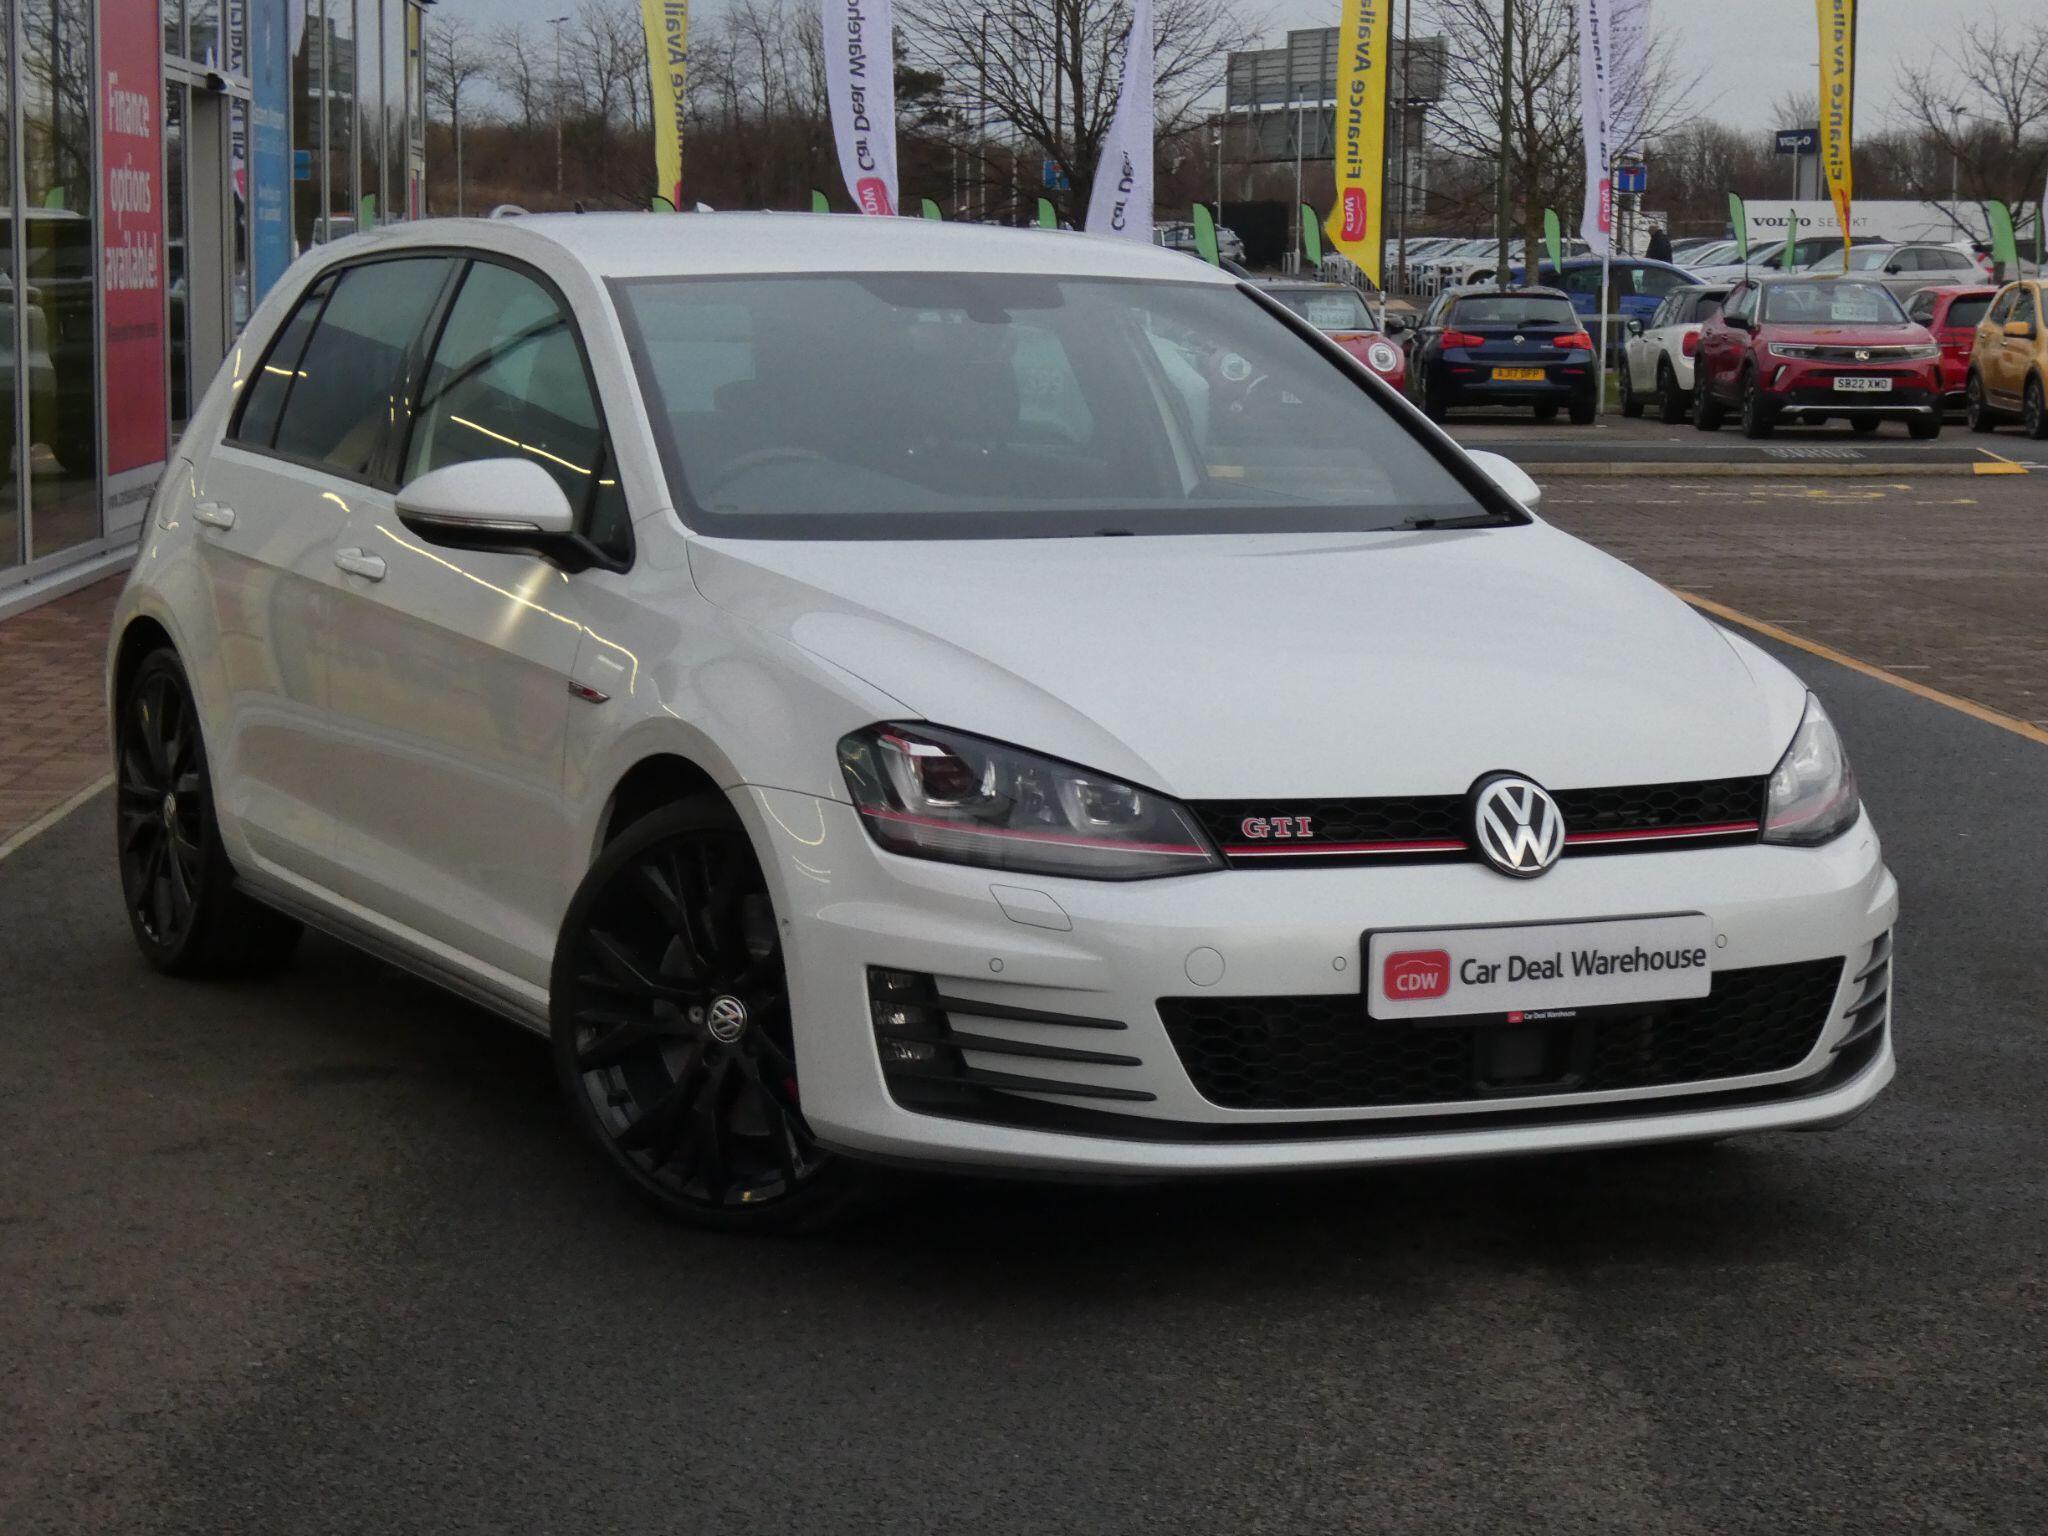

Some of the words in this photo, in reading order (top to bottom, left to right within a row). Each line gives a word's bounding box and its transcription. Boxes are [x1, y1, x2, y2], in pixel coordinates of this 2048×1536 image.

[107, 71, 150, 138] Finance
[110, 152, 150, 229] options
[1818, 217, 1869, 227] SEKT
[106, 230, 158, 292] available!
[1838, 378, 1865, 389] SB22
[1241, 816, 1313, 838] GTI
[1460, 958, 1502, 985] Car
[1508, 952, 1562, 982] Deal
[1571, 946, 1706, 976] Warehouse
[1396, 972, 1439, 991] CDW
